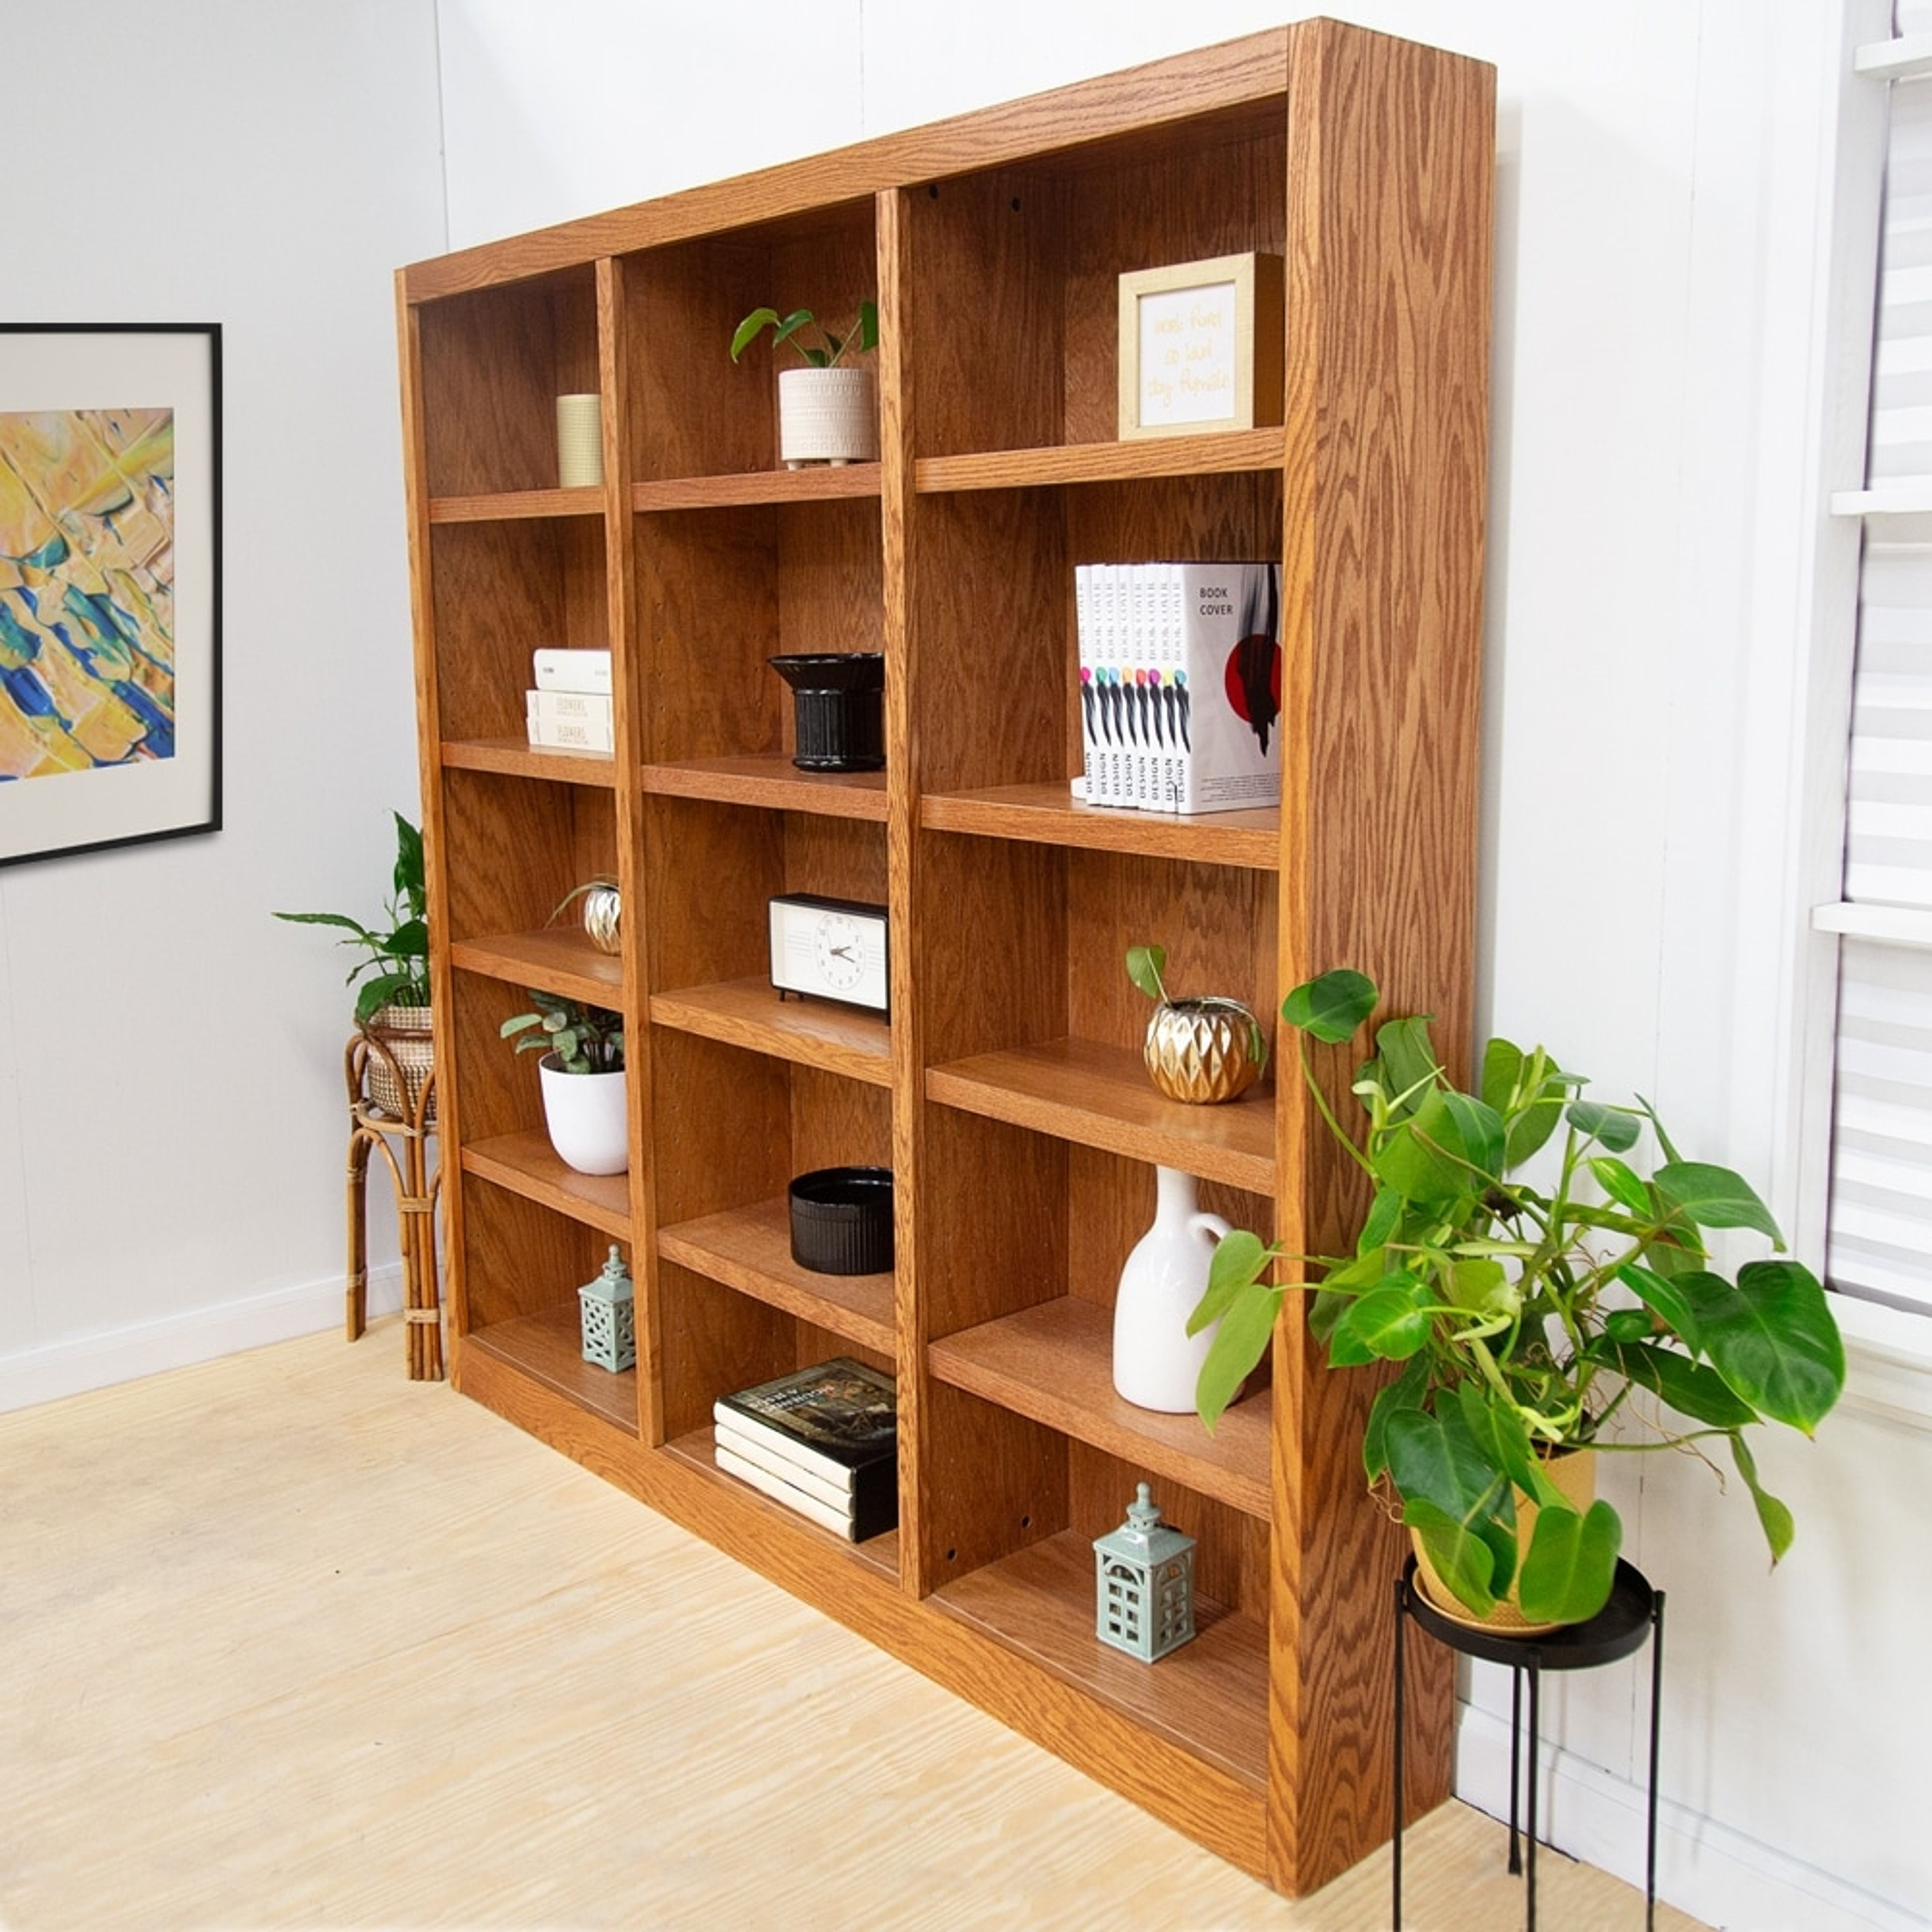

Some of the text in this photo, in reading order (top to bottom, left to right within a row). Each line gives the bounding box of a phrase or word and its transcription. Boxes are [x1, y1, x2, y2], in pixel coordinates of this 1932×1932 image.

[1200, 587, 1228, 598] BOOK
[1200, 604, 1233, 615] COVER
[1099, 753, 1107, 794] DESIGN
[1151, 757, 1159, 800] DESIGN
[1165, 758, 1173, 801] DESIGN
